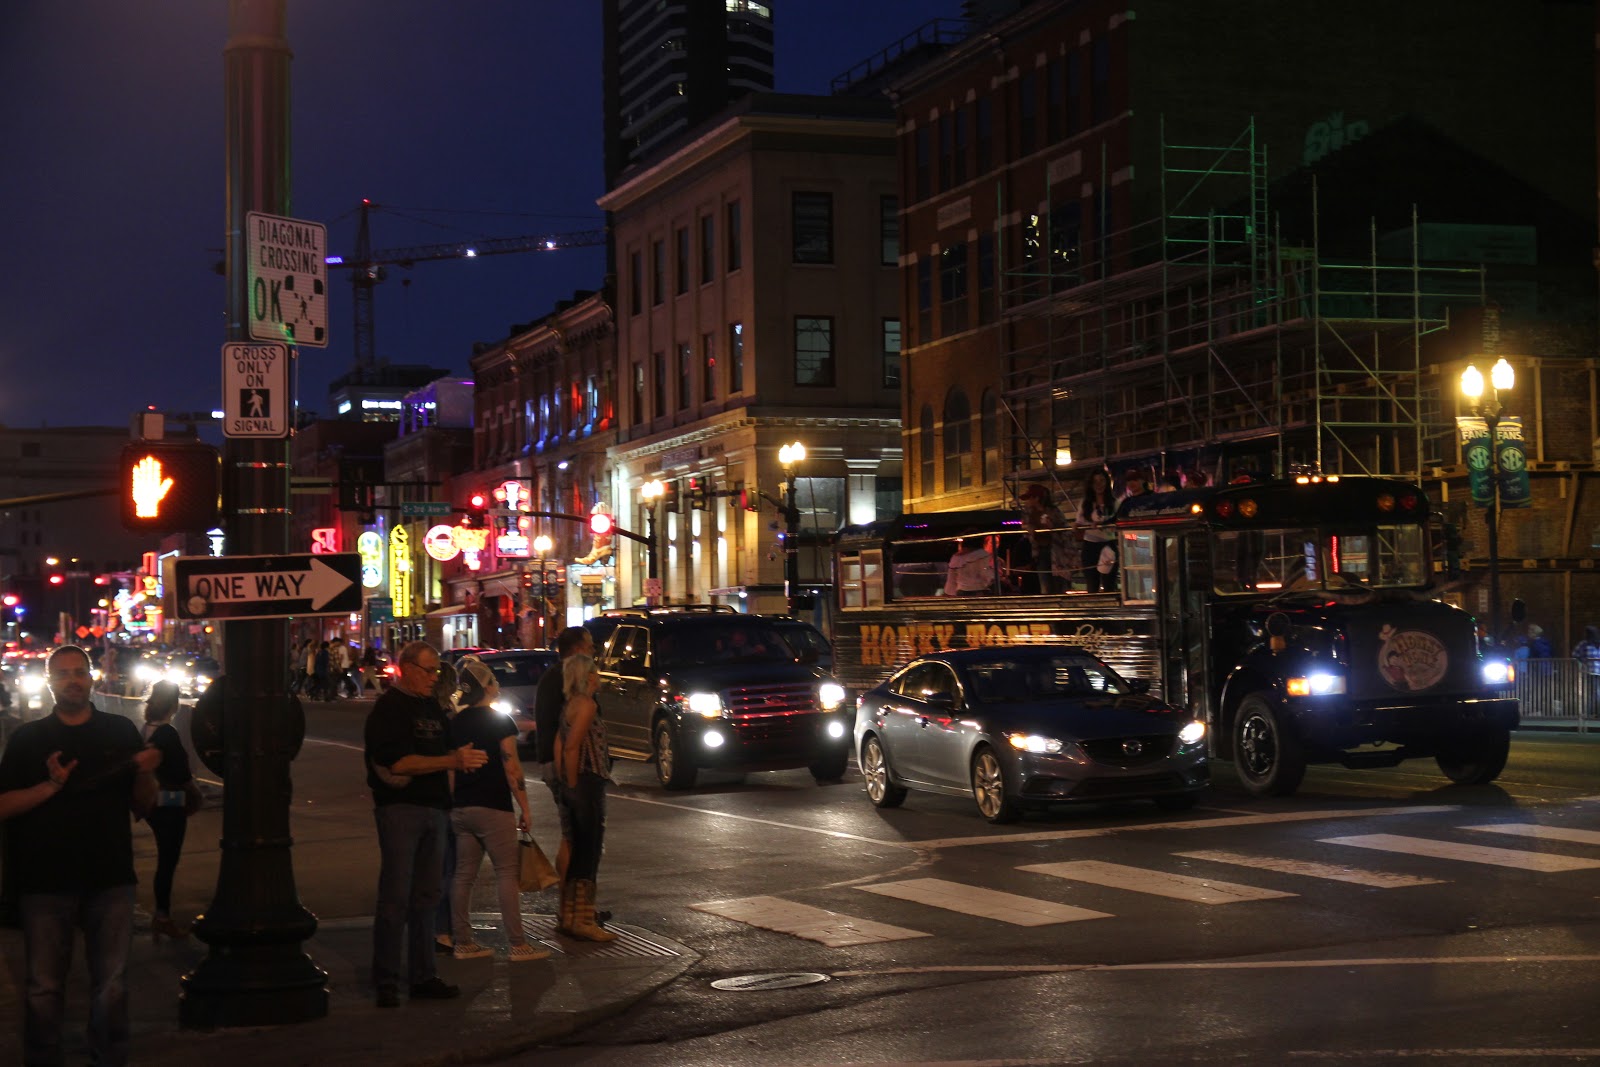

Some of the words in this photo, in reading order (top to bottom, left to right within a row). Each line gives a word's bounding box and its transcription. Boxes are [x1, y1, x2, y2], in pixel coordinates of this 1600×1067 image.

[258, 219, 319, 251] DIAGONAL
[260, 245, 318, 275] CROSSING
[253, 277, 284, 323] OK
[233, 347, 277, 361] CROSS
[236, 361, 272, 374] ONLY
[246, 374, 264, 388] ON
[234, 420, 276, 432] SIGNAL
[1461, 429, 1489, 440] FANS
[1496, 431, 1523, 440] FANS
[196, 576, 246, 600] ONE
[255, 573, 306, 597] WAY
[859, 624, 955, 666] HONKY
